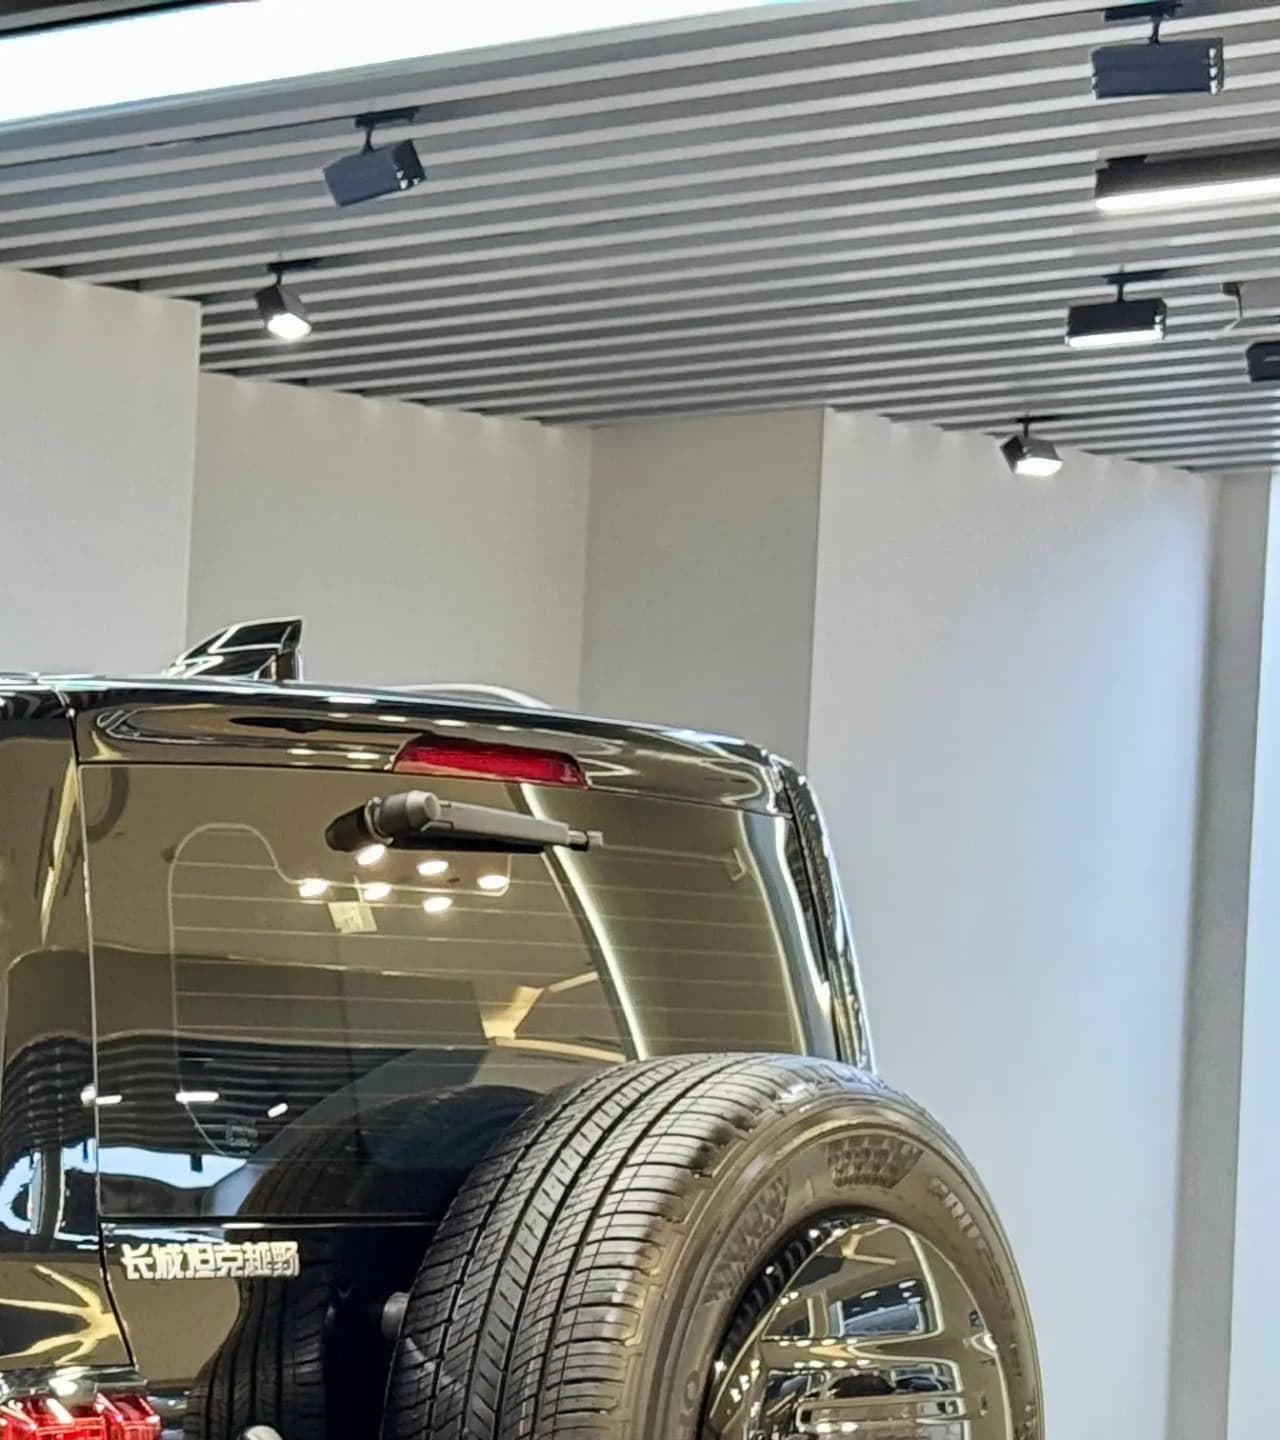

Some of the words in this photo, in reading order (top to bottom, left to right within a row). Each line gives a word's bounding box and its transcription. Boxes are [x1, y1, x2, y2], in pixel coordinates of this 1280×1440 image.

[120, 1240, 301, 1281] 长城坦克越野
